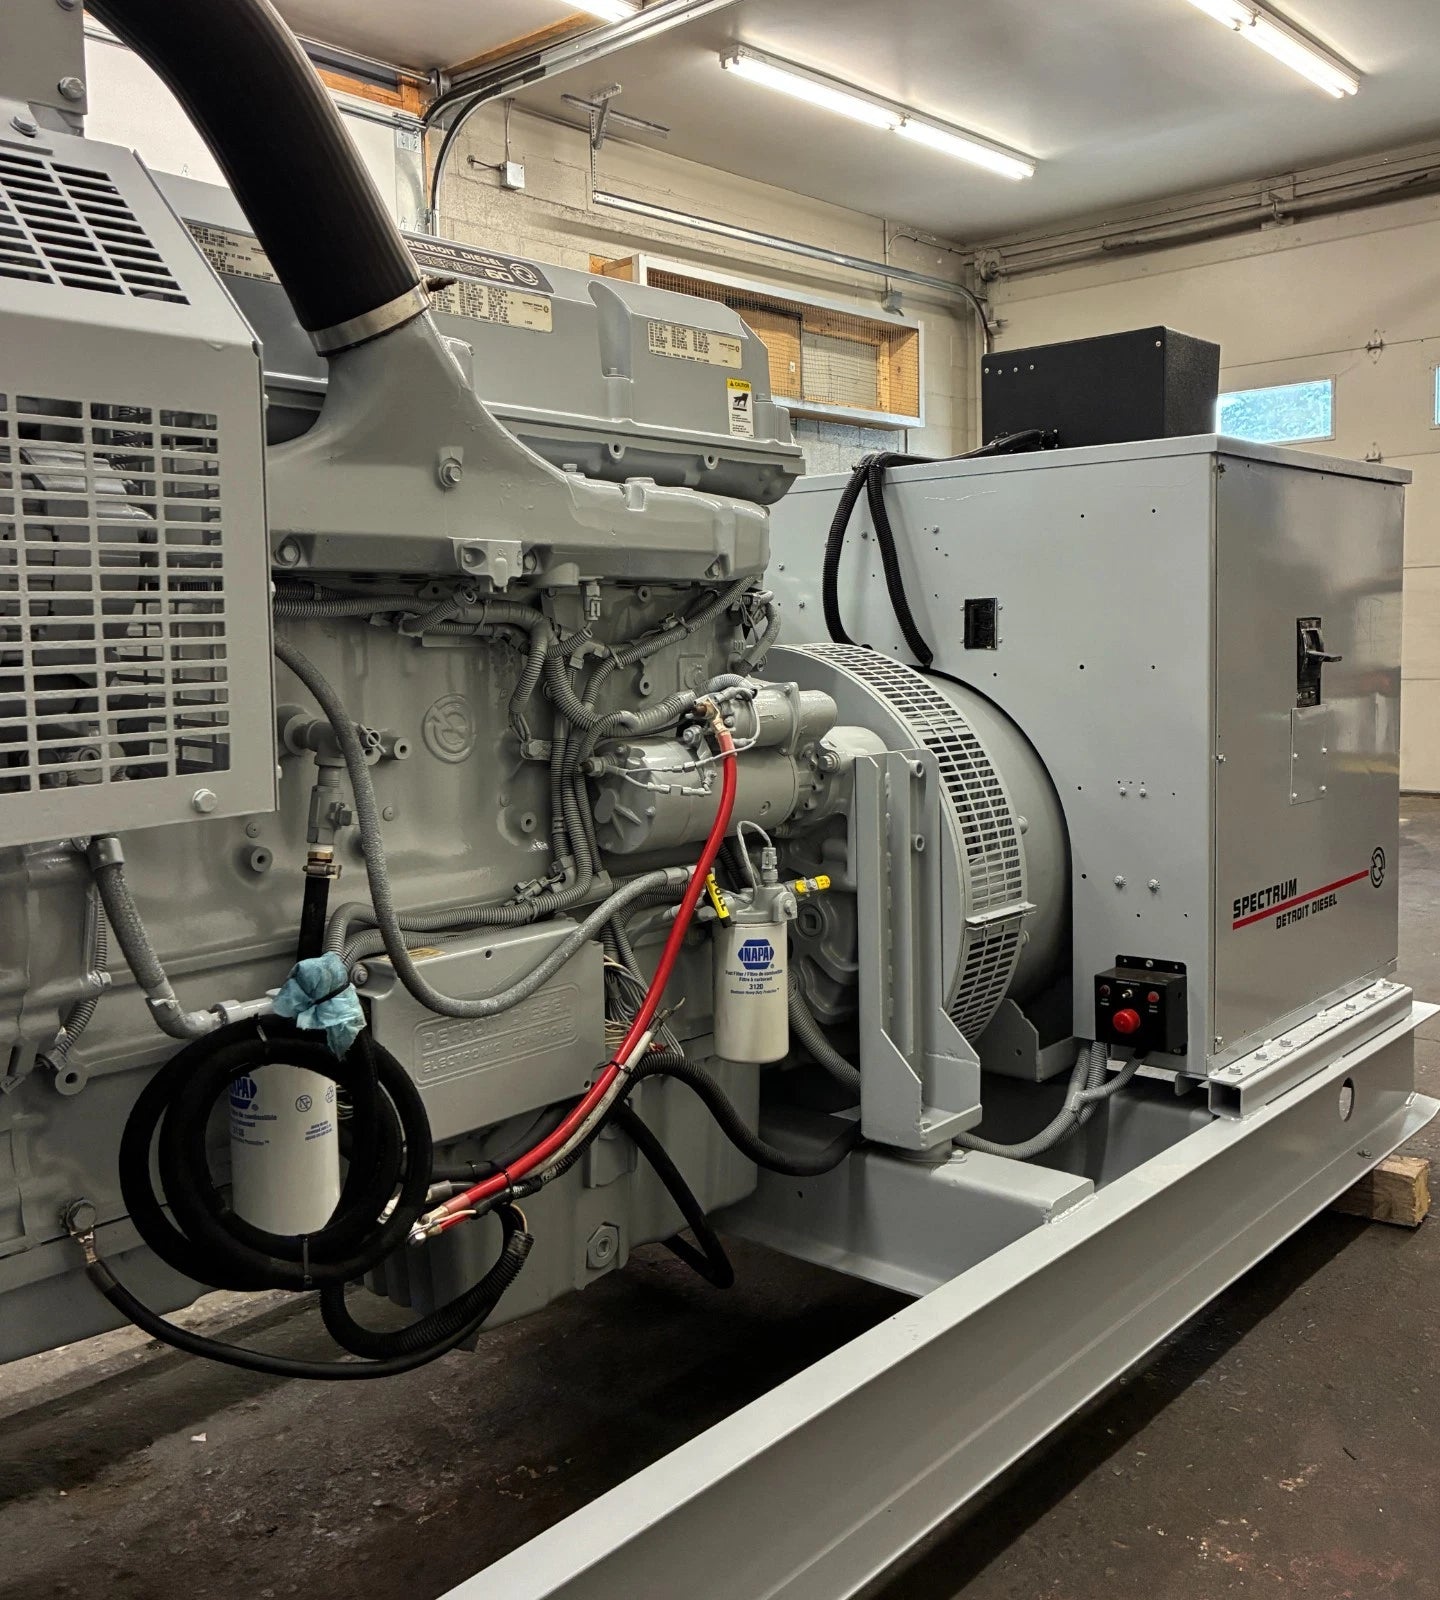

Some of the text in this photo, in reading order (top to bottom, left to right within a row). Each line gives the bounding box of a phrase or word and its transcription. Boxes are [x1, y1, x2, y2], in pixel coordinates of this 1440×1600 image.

[406, 240, 504, 267] DETROIT DIESEL
[485, 268, 514, 282] 60
[735, 381, 750, 389] CAUTION
[1233, 878, 1297, 919] SPECTRUM
[1276, 893, 1338, 930] DETROIT DIESEL
[742, 945, 771, 963] NAPA
[421, 1013, 503, 1050] DETROIT
[422, 1041, 501, 1074] ELECTRONIC
